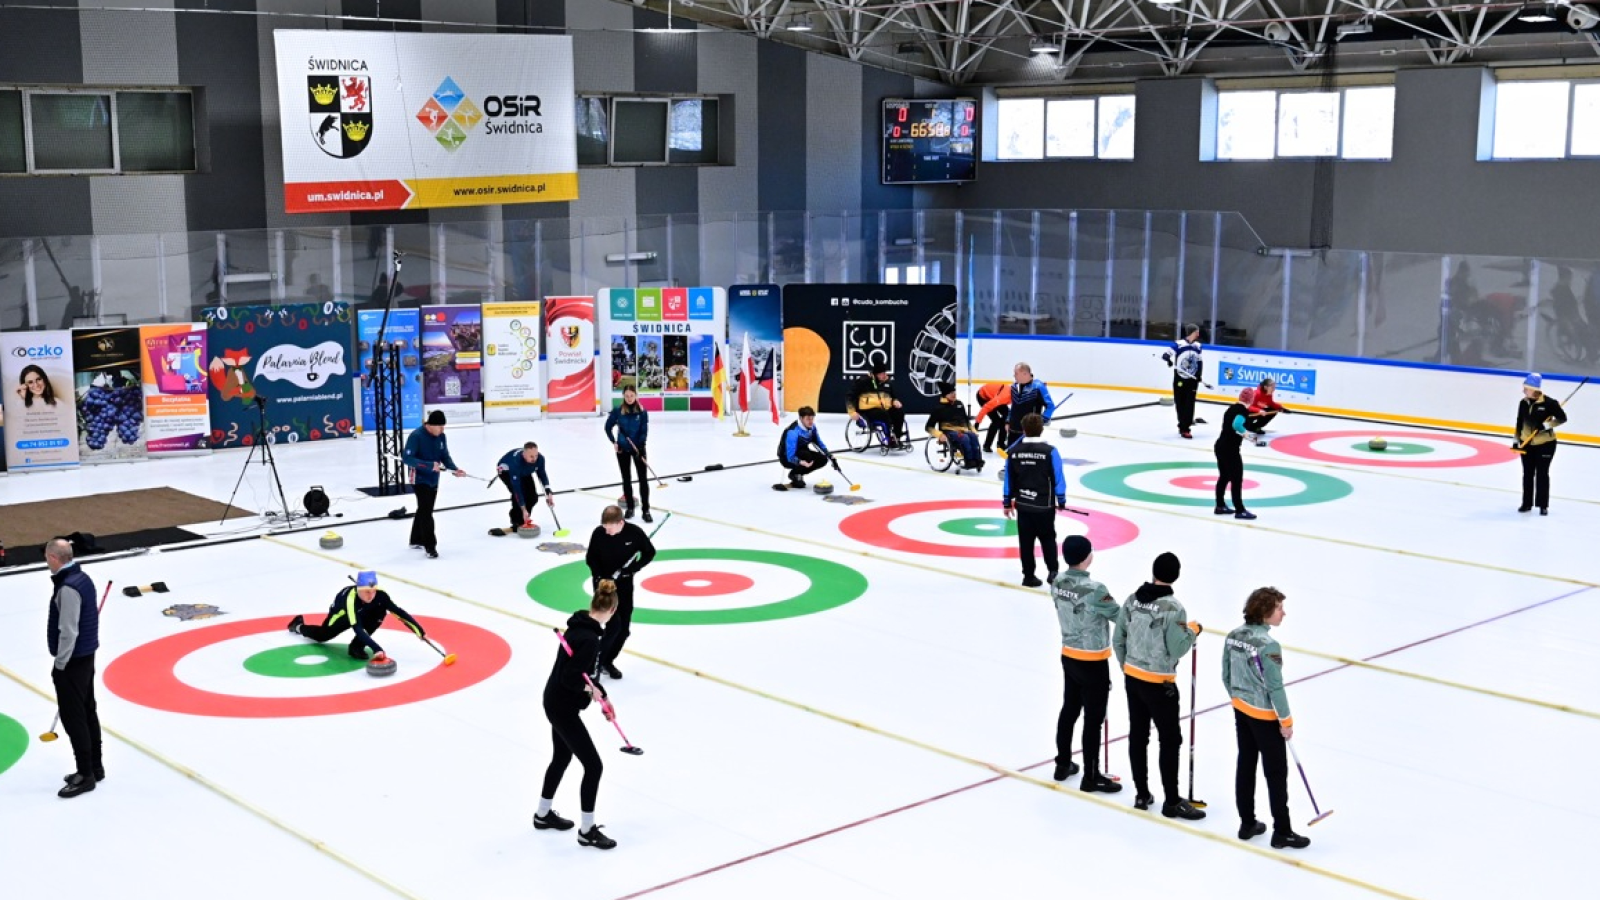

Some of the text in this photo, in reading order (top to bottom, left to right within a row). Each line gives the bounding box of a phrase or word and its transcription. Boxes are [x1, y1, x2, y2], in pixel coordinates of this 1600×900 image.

[308, 55, 369, 71] ŚWIDNICA
[483, 95, 542, 117] OSiR
[898, 107, 907, 122] 0
[485, 118, 543, 135] Świdnica
[307, 189, 384, 203] um.swidnica.pl
[454, 184, 546, 197] www.osir.swidnica.pl
[632, 322, 692, 334] ŚWIDNICA
[18, 344, 63, 357] oczko
[558, 350, 583, 358] Powiat
[262, 350, 341, 370] Palarnia Blend
[554, 357, 588, 366] Świdnicki
[1237, 366, 1295, 384] ŚWIDNICA
[276, 392, 343, 403] www.palarniablend.pl
